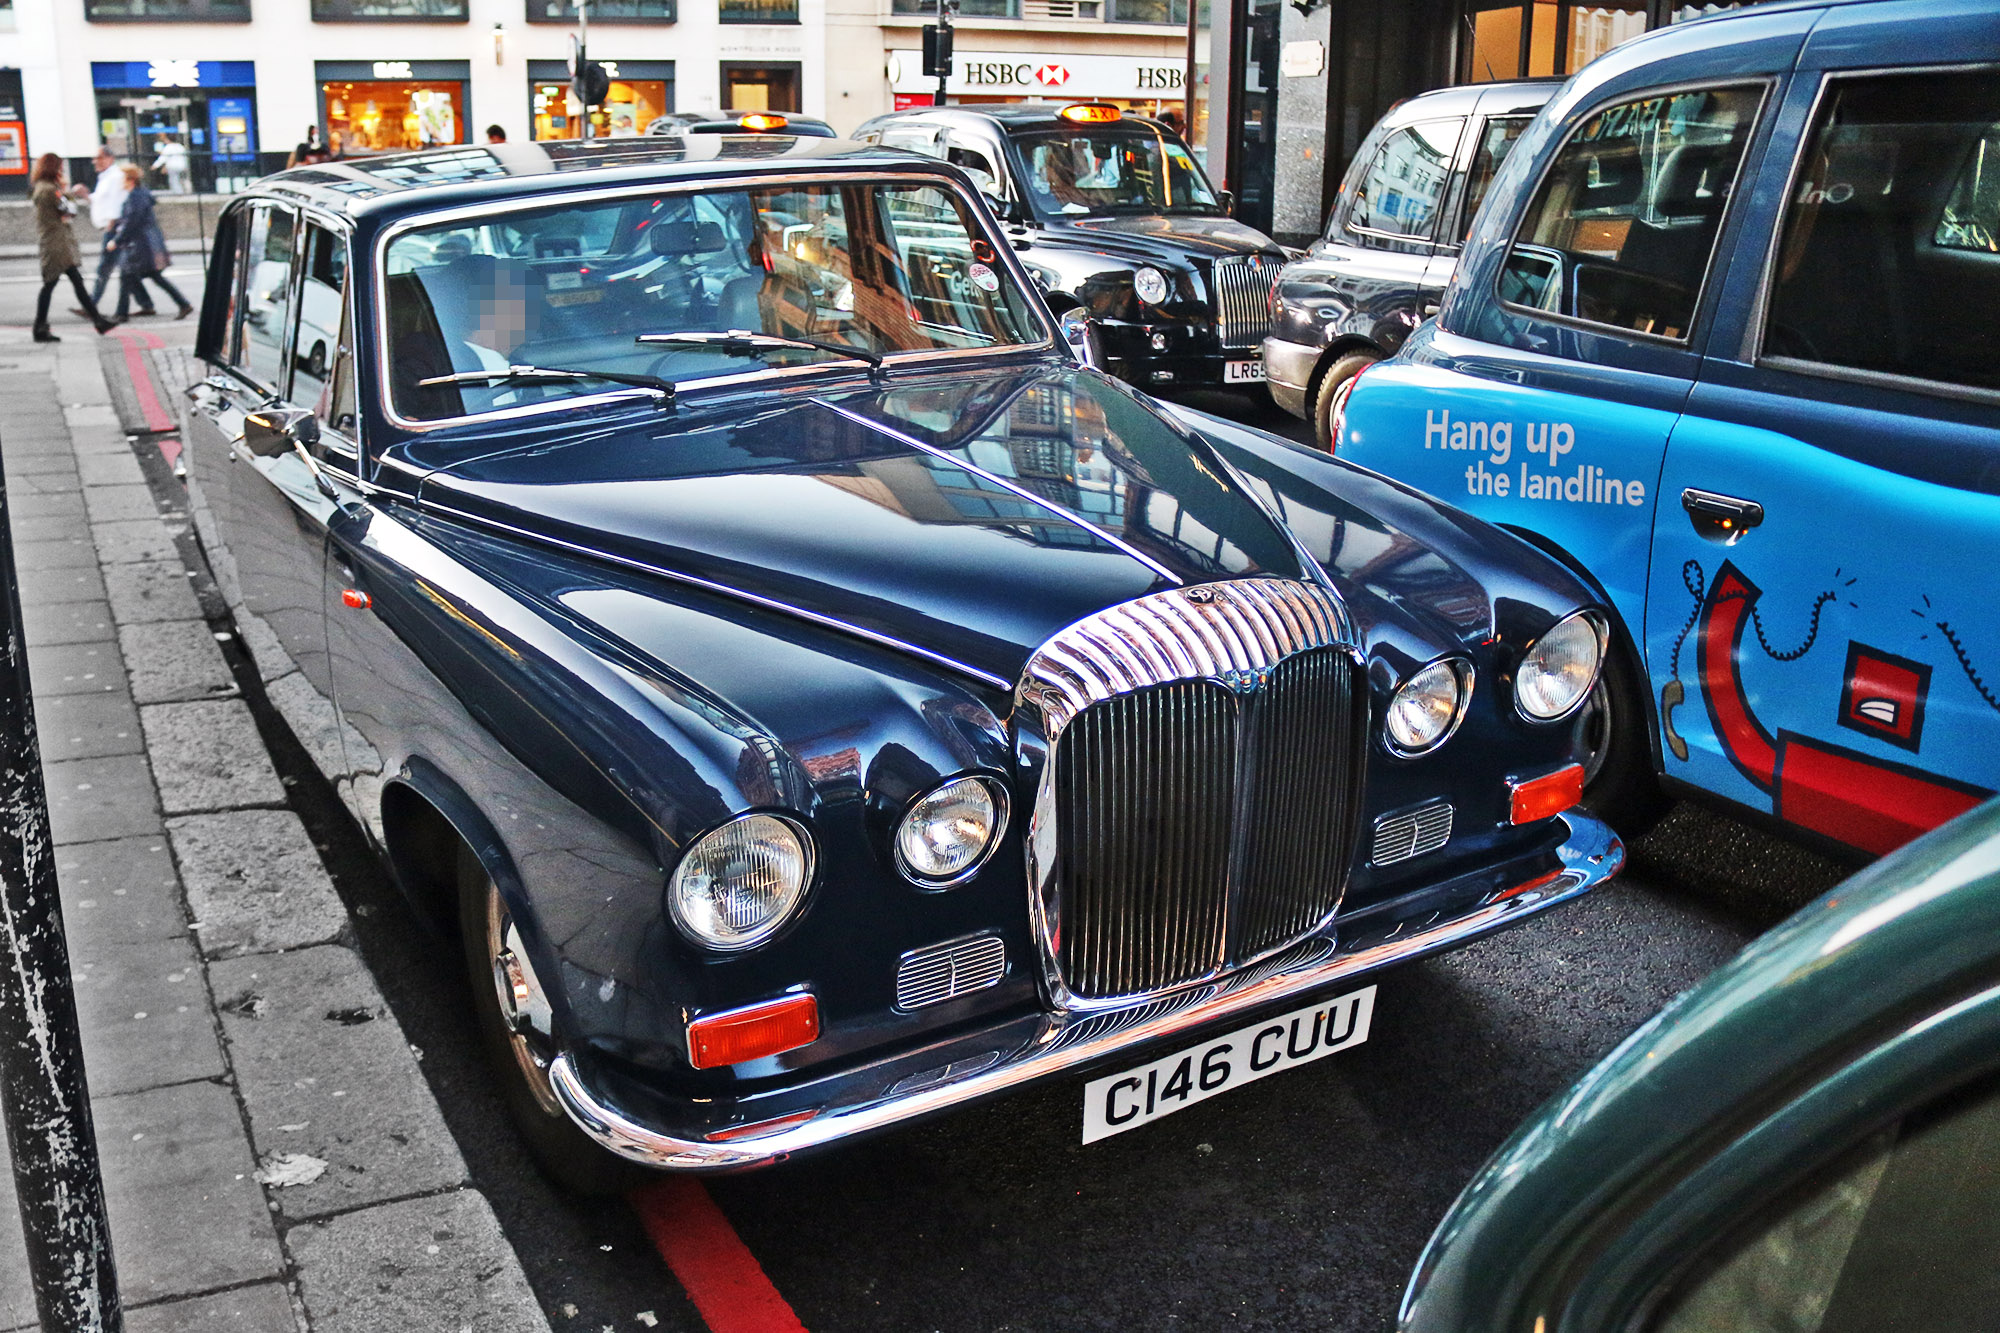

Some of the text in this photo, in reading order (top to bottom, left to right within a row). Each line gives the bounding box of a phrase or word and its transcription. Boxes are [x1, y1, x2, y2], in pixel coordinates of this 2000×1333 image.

[965, 62, 1032, 85] HSBC
[1425, 409, 1575, 467] Hang up
[1465, 460, 1646, 507] the landline
[1105, 998, 1361, 1127] C146 CUU
